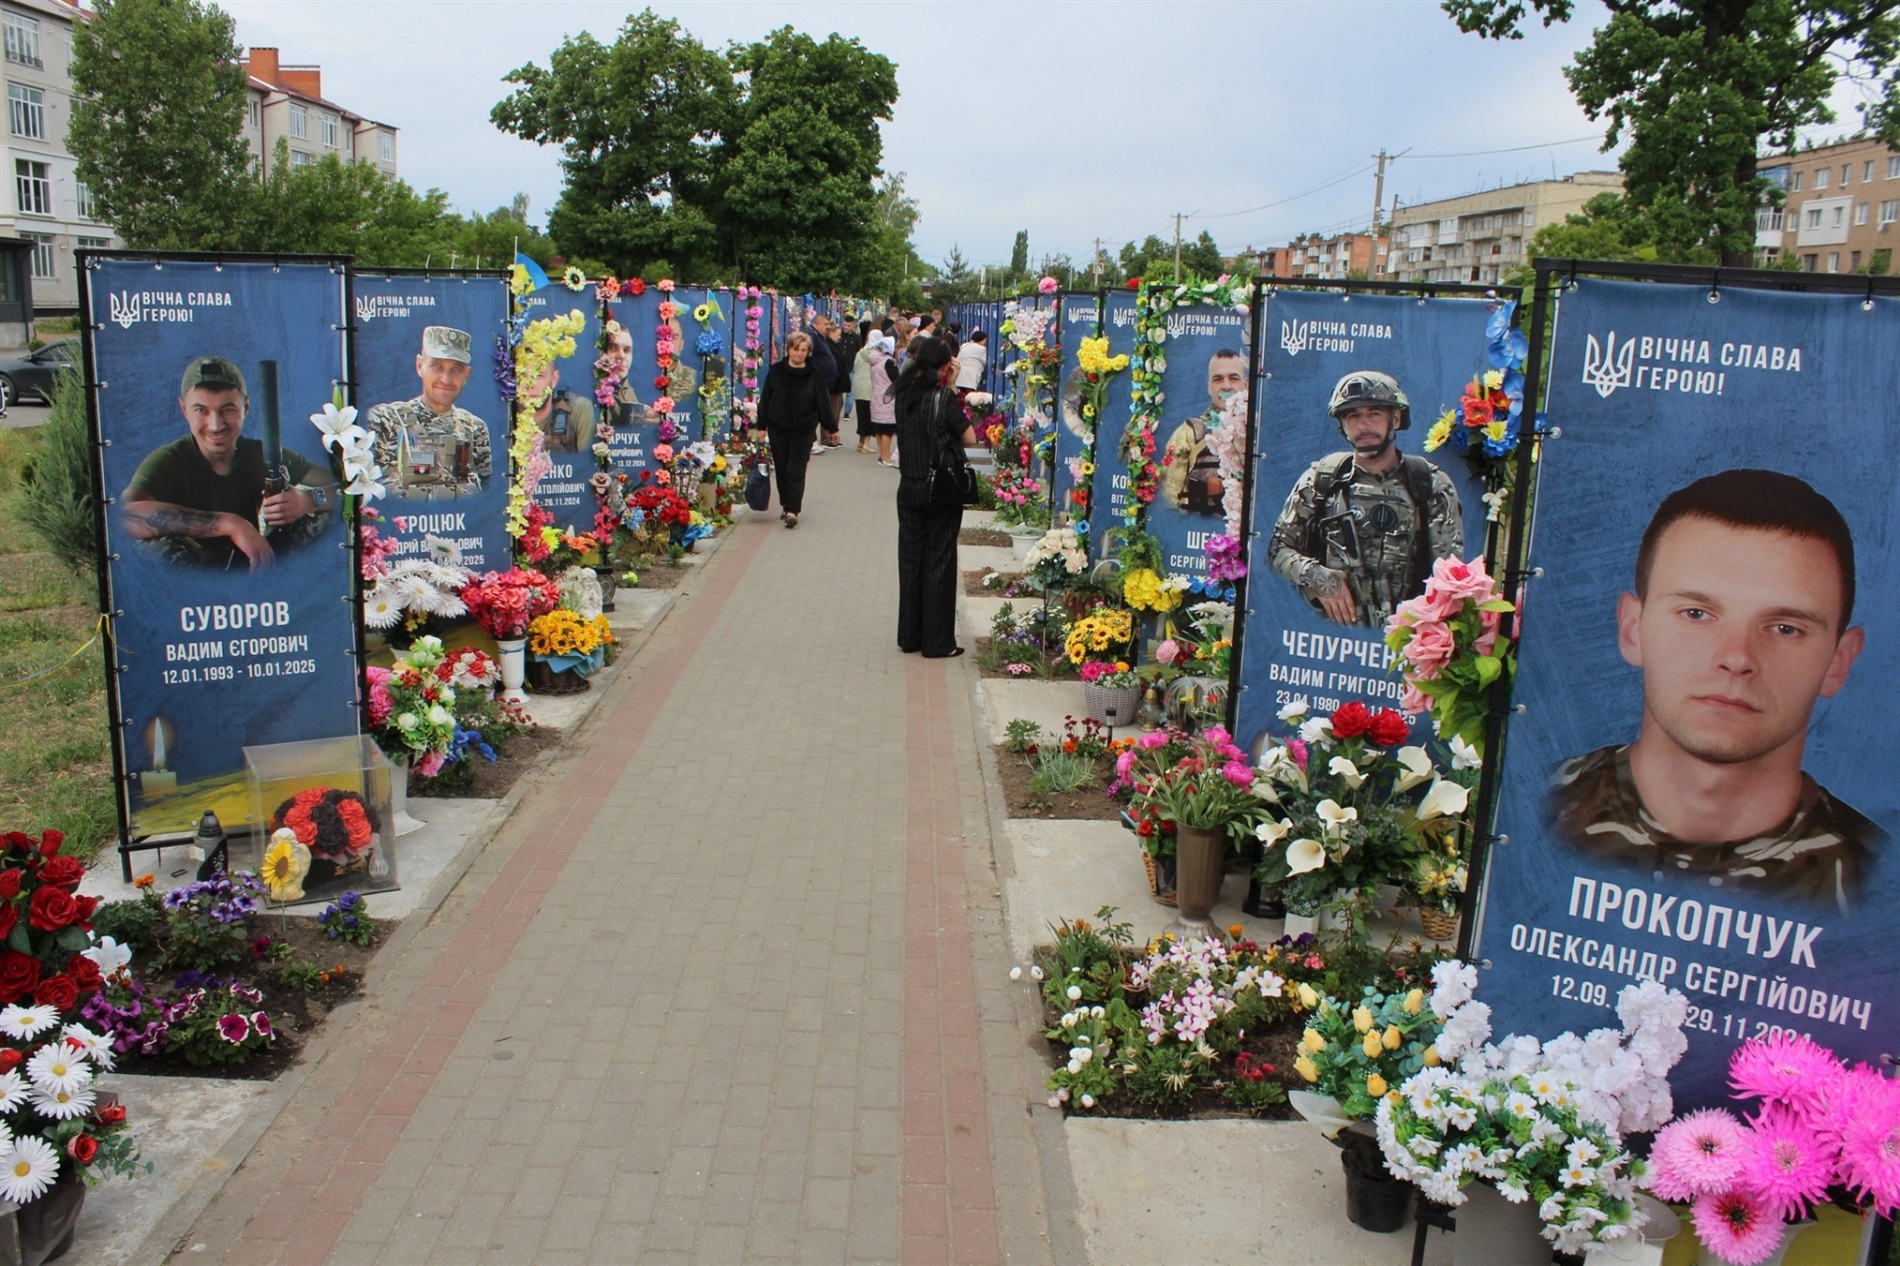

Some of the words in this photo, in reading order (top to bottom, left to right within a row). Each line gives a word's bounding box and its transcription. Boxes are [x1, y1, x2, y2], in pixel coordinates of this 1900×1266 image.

[142, 291, 184, 306] ВІЧНА
[188, 292, 232, 306] СЛАВА
[377, 296, 404, 306] ВІЧНА
[406, 296, 436, 306] СЛАВА
[143, 308, 193, 322] ГЕРОЮ!
[377, 307, 410, 318] ГЕРОЮ!
[1186, 314, 1211, 324] ВІЧНА
[1214, 315, 1241, 326] СЛАВА
[1186, 326, 1216, 336] ГЕРОЮ!
[1310, 321, 1346, 336] ВІЧНА
[1351, 323, 1392, 339] СЛАВА
[1309, 337, 1354, 353] ГЕРОЮ!
[1640, 336, 1710, 364] ВІЧНА
[1720, 342, 1801, 372] СЛАВА
[1636, 366, 1725, 395] ГЕРОЮ!
[609, 432, 640, 445] АРЧУК
[394, 539, 419, 555] ДРІЙ
[1170, 554, 1206, 570] СЕРГІЙ
[181, 601, 290, 632] СУВОРОВ
[166, 641, 224, 662] ВАДИМ
[229, 635, 308, 656] ЄГОРОВИЧ
[1283, 629, 1405, 671] ЧЕПУРЧЕН
[163, 666, 234, 684] 12.01.1993
[247, 659, 316, 678] 10.01.2025
[1270, 663, 1323, 688] ВАДИМ
[1328, 673, 1404, 700] ГРИГОРОВ
[1568, 875, 1824, 970] ПРОКОПЧУК
[1510, 924, 1677, 984] ОЛЕКСАНДР
[1684, 961, 1872, 1031] СЕРГІЙОВИЧ
